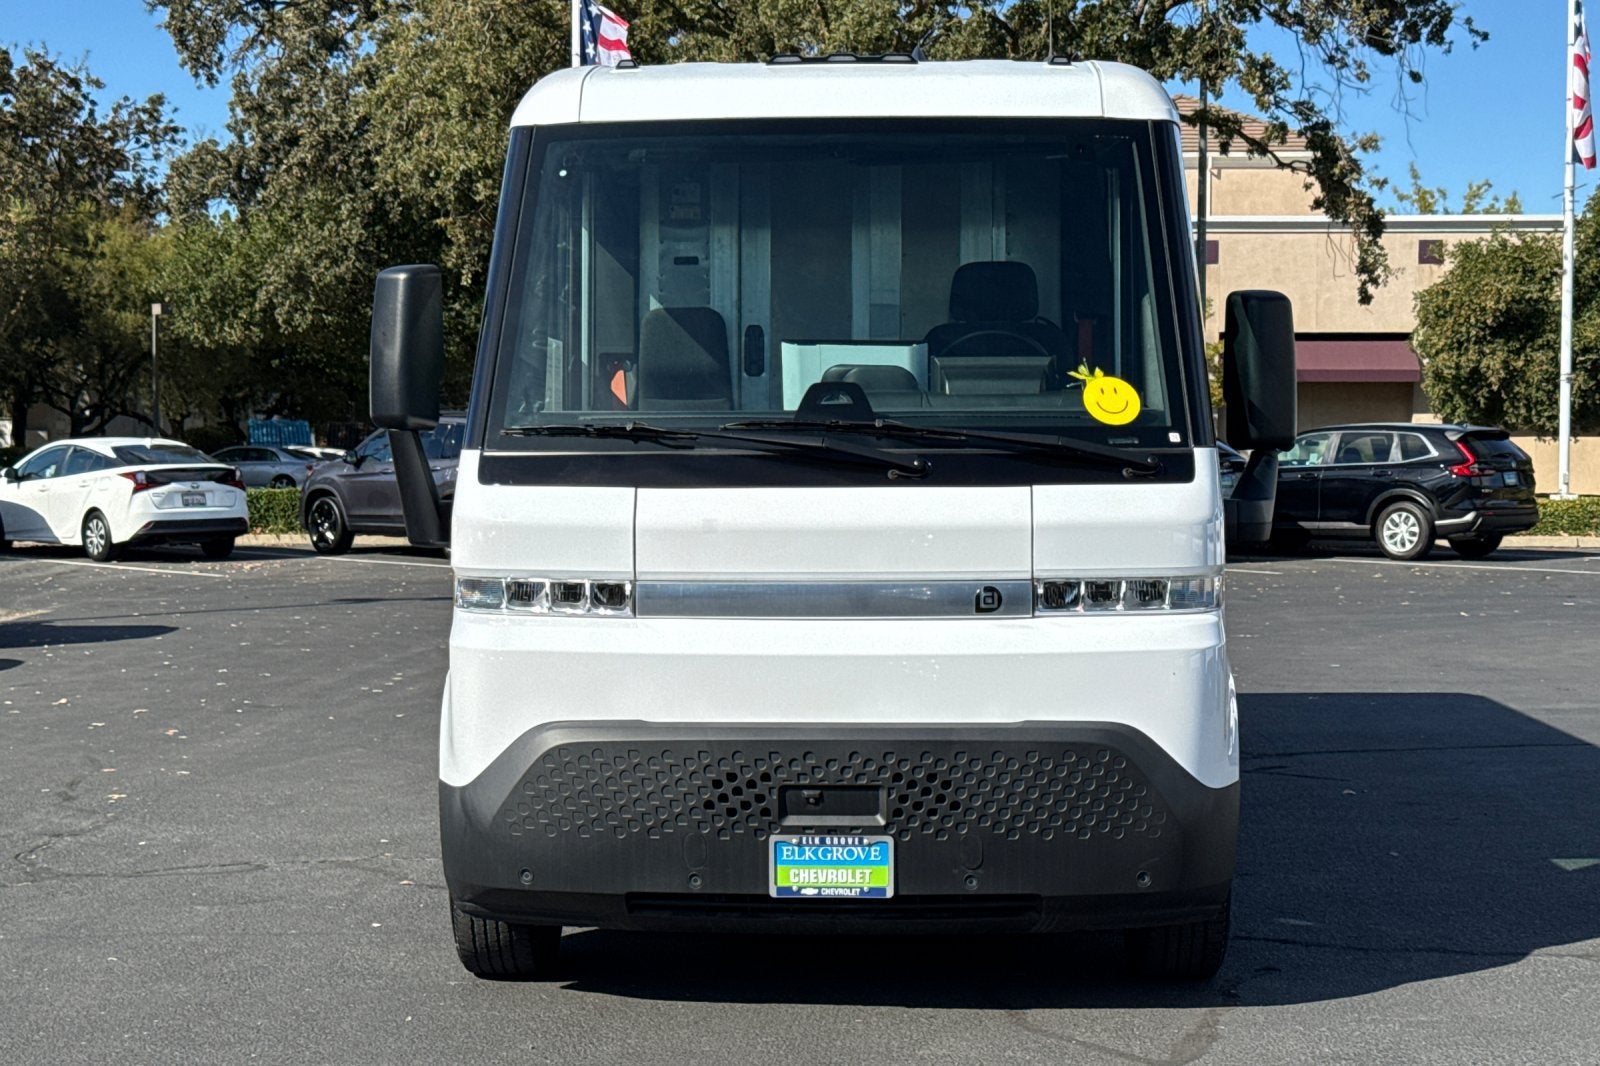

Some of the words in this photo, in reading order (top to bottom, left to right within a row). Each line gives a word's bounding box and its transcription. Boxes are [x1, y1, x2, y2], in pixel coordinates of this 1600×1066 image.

[802, 836, 820, 845] ELK
[825, 836, 859, 845] GROVE
[789, 868, 873, 884] CHEVROLET
[820, 887, 861, 896] CHEVROLET
